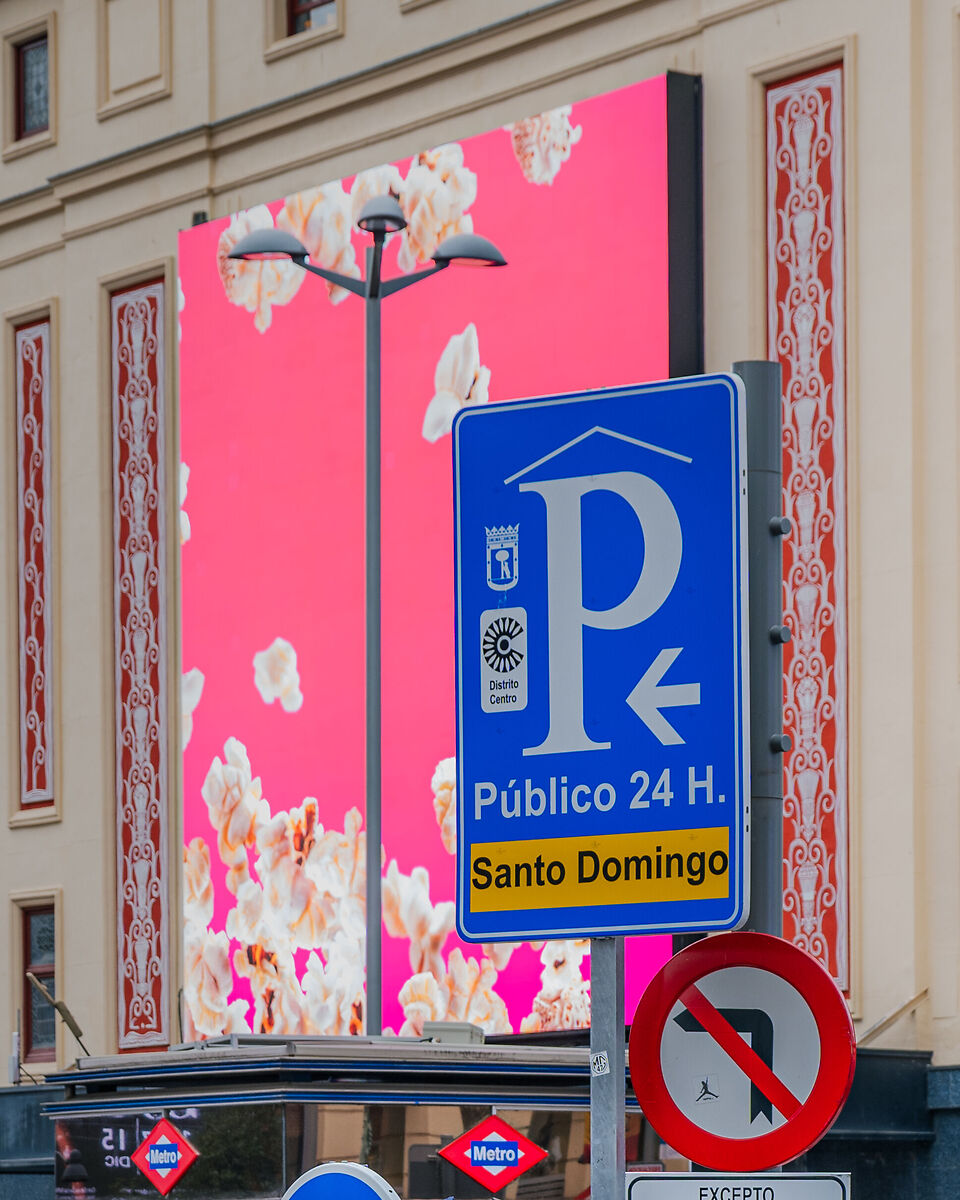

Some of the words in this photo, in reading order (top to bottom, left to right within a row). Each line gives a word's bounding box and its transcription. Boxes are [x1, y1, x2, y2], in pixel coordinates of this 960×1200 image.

[519, 471, 683, 757] P
[489, 679, 519, 691] Distrito
[489, 694, 517, 705] Centro
[474, 776, 616, 820] Público
[629, 768, 674, 809] 24
[688, 765, 726, 805] H.
[472, 855, 565, 889] Santo
[578, 846, 729, 886] Domingo
[150, 1149, 177, 1165] Metro
[473, 1146, 516, 1161] Metro
